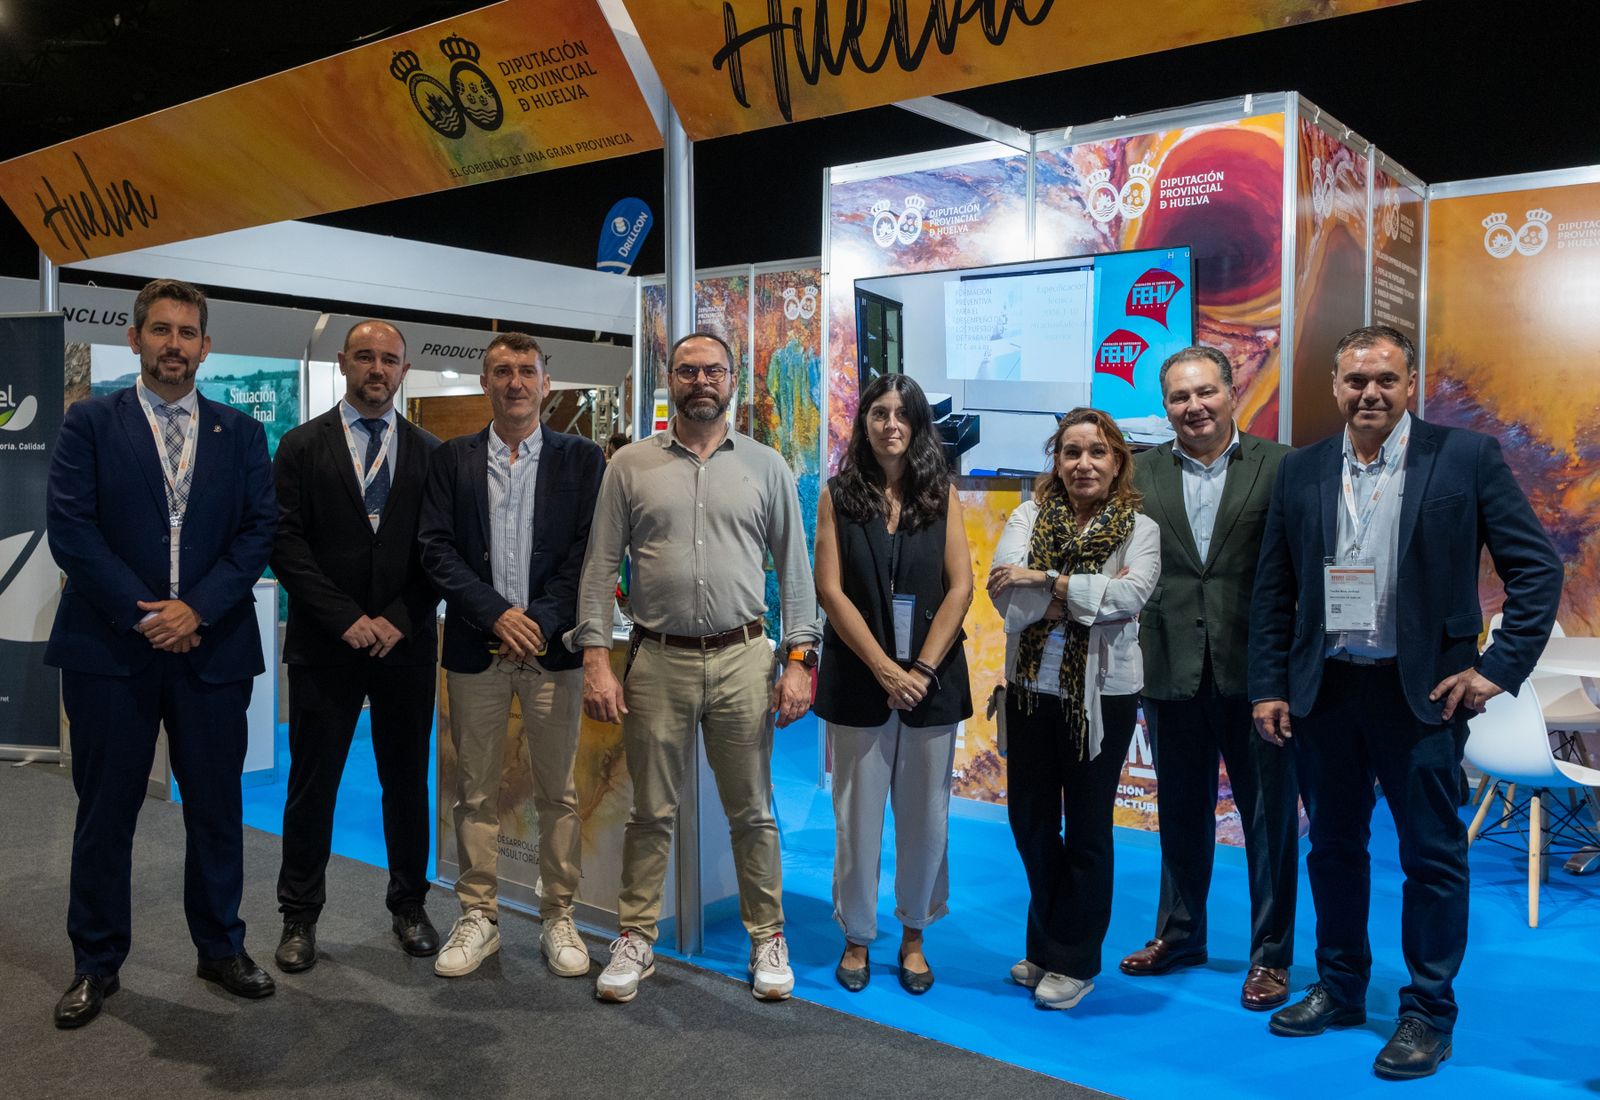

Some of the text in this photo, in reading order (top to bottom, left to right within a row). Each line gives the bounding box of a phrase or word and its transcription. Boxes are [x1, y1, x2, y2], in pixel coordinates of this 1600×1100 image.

[497, 40, 590, 77] DIPUTACIÓN
[508, 61, 598, 94] PROVINCIAL
[530, 84, 590, 109] HUELVA
[450, 133, 634, 178] EL GOBIERNO DE UNA GRAN PROVINCIA
[1160, 170, 1225, 188] DIPUTACIÓN
[1160, 183, 1224, 199] PROVINCIAL
[1169, 195, 1210, 209] HUELVA
[34, 151, 158, 259] Huelva
[618, 211, 649, 257] DRILLCON
[229, 383, 277, 404] Situación
[254, 404, 276, 422] final
[18, 442, 46, 451] Calidad
